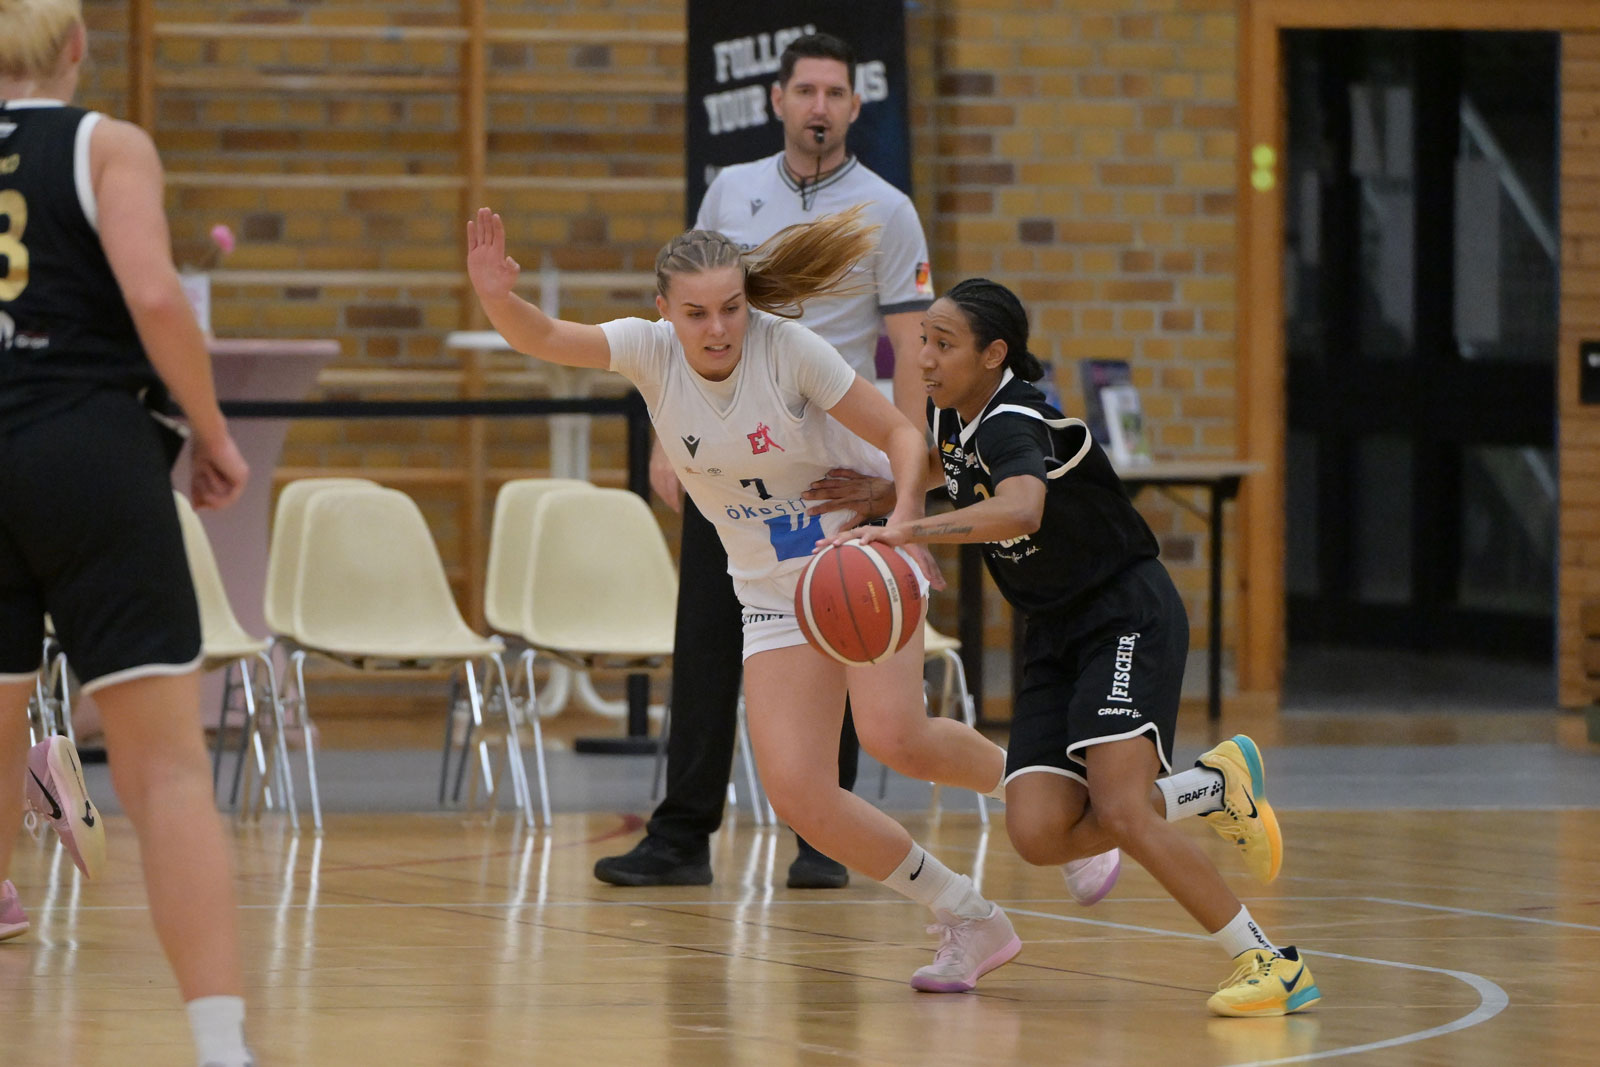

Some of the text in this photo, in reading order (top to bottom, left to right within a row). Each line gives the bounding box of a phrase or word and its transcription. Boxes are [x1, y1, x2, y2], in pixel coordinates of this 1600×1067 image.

[714, 24, 816, 83] FOLLO
[704, 85, 769, 135] YOUR
[739, 478, 773, 501] 7
[724, 497, 809, 520] ökostr
[1098, 707, 1133, 716] CRAFT
[1177, 786, 1209, 805] CRAFT
[1247, 921, 1272, 950] CRAFT
